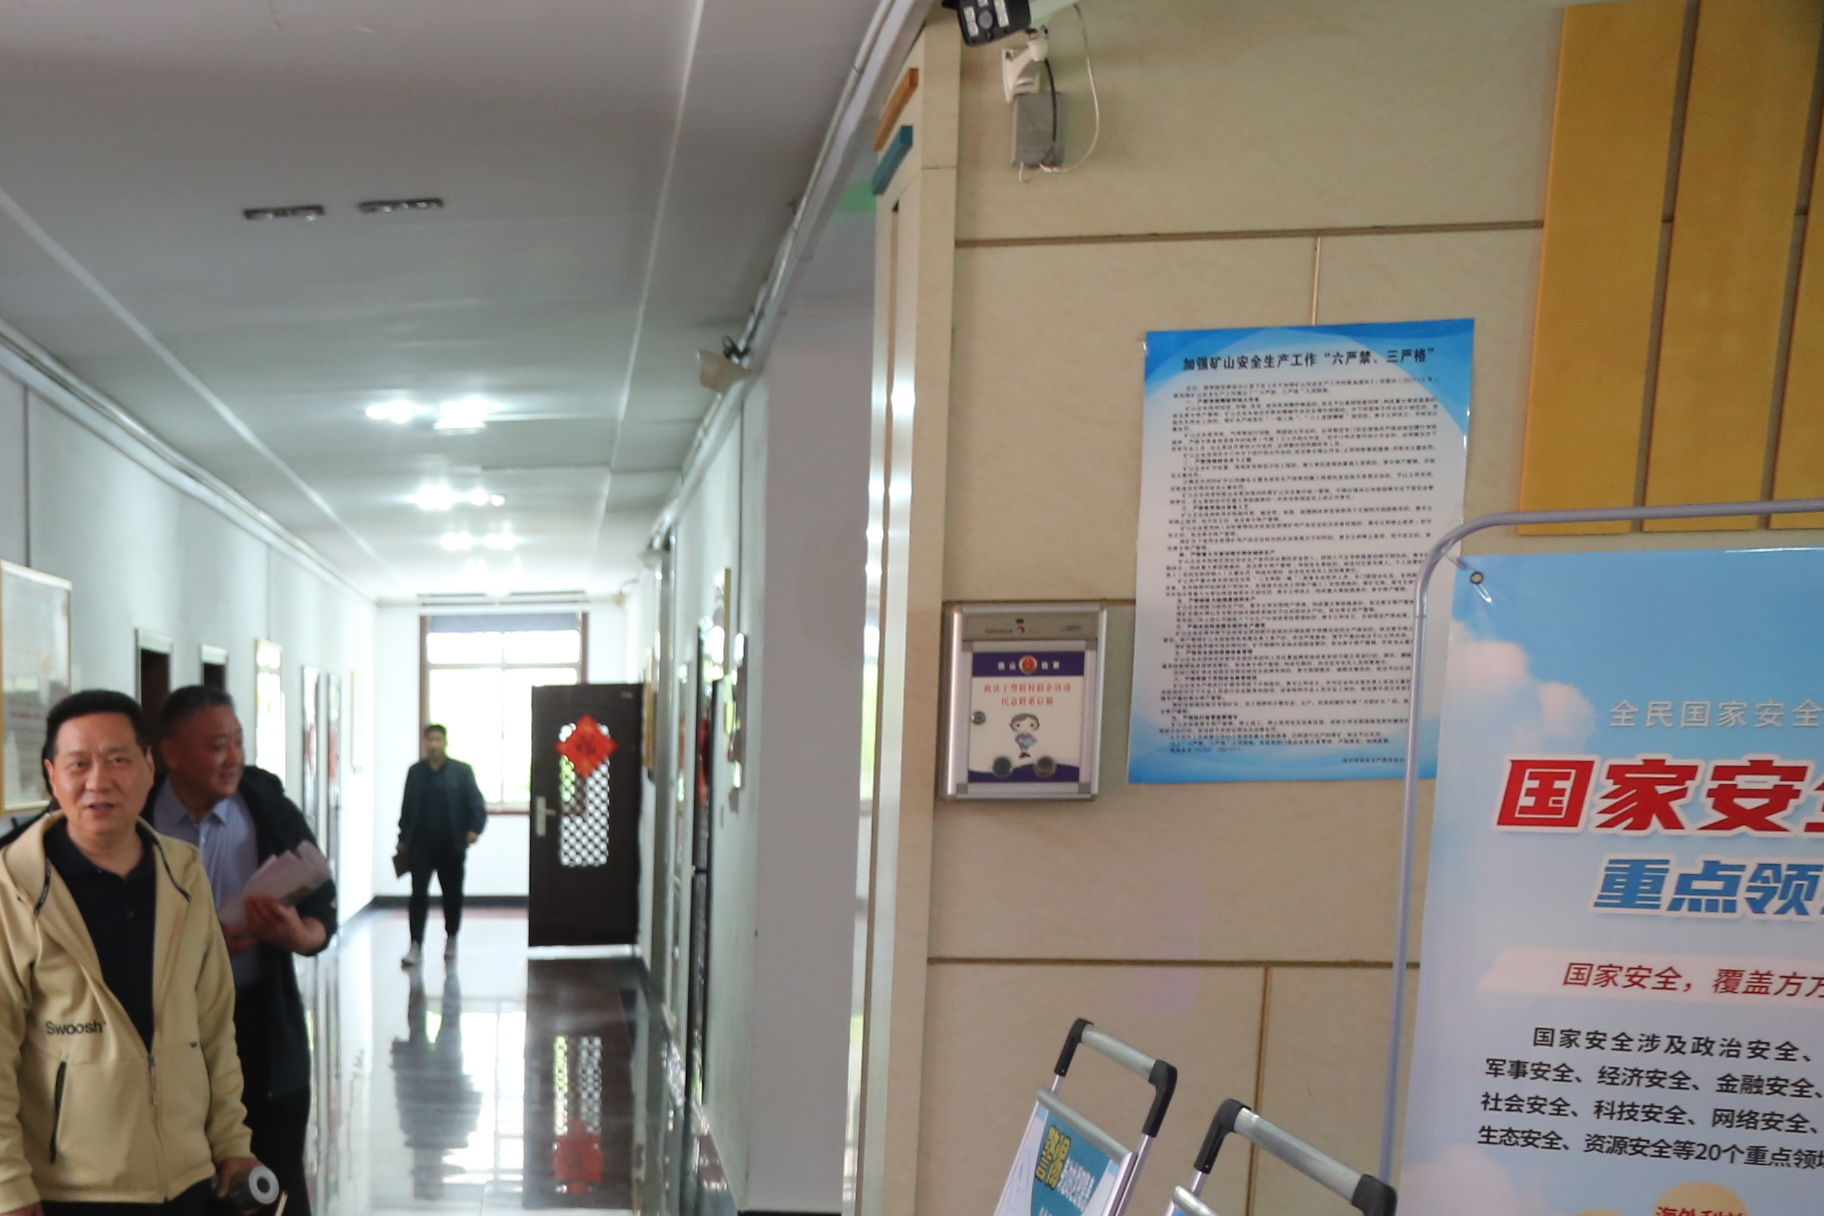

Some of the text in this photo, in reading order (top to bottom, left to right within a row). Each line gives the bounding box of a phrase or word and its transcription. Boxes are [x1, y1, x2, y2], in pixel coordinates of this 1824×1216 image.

[1609, 698, 1824, 730] 全民国家安全
[1593, 856, 1824, 917] 重点领
[45, 1020, 103, 1035] Swoosh
[1533, 1026, 1811, 1063] 国家安全涉及政治安全、
[1485, 1058, 1823, 1099] 军事安全、经济安全、金融安全、
[1480, 1092, 1818, 1135] 社会安全、科技安全、网络安全、
